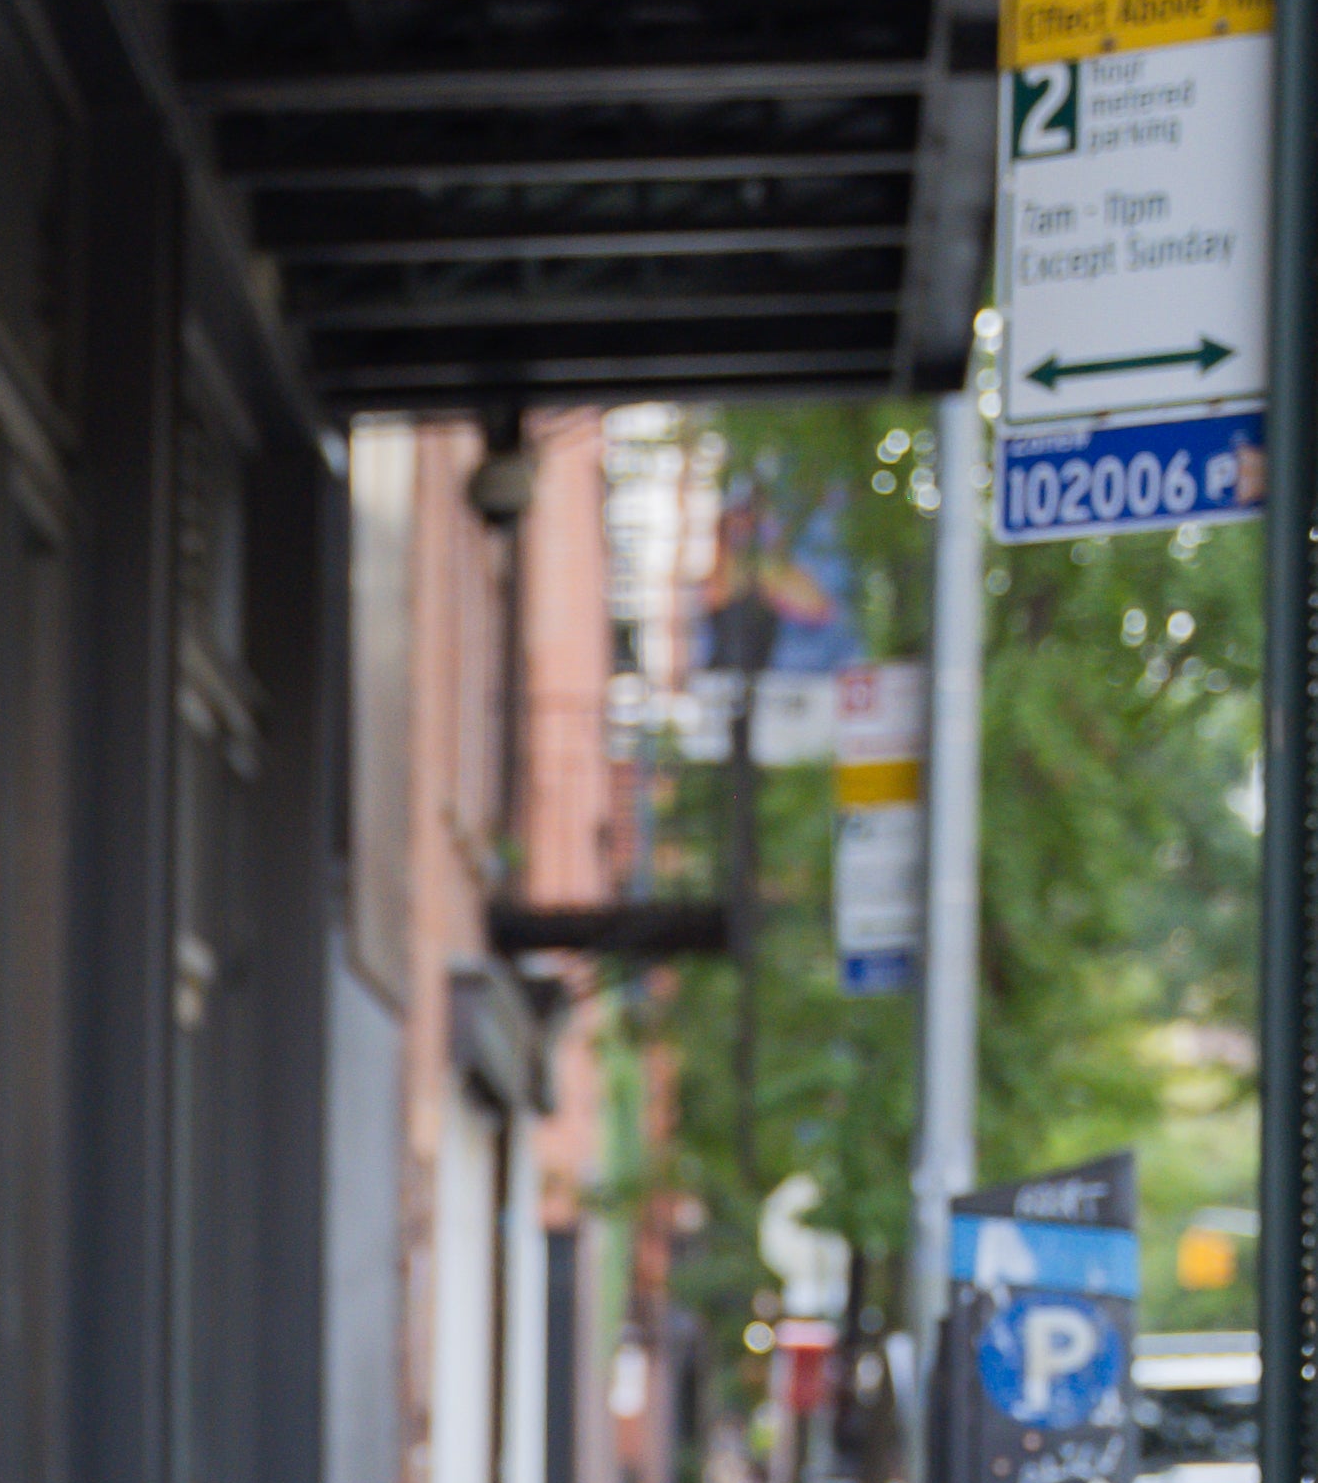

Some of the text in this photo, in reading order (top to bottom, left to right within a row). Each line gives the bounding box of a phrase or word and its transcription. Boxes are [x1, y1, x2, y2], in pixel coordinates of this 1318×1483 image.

[1020, 62, 1072, 153] 2
[1125, 226, 1235, 272] Sunday
[1008, 450, 1198, 527] 102006
[1023, 1306, 1097, 1412] P
